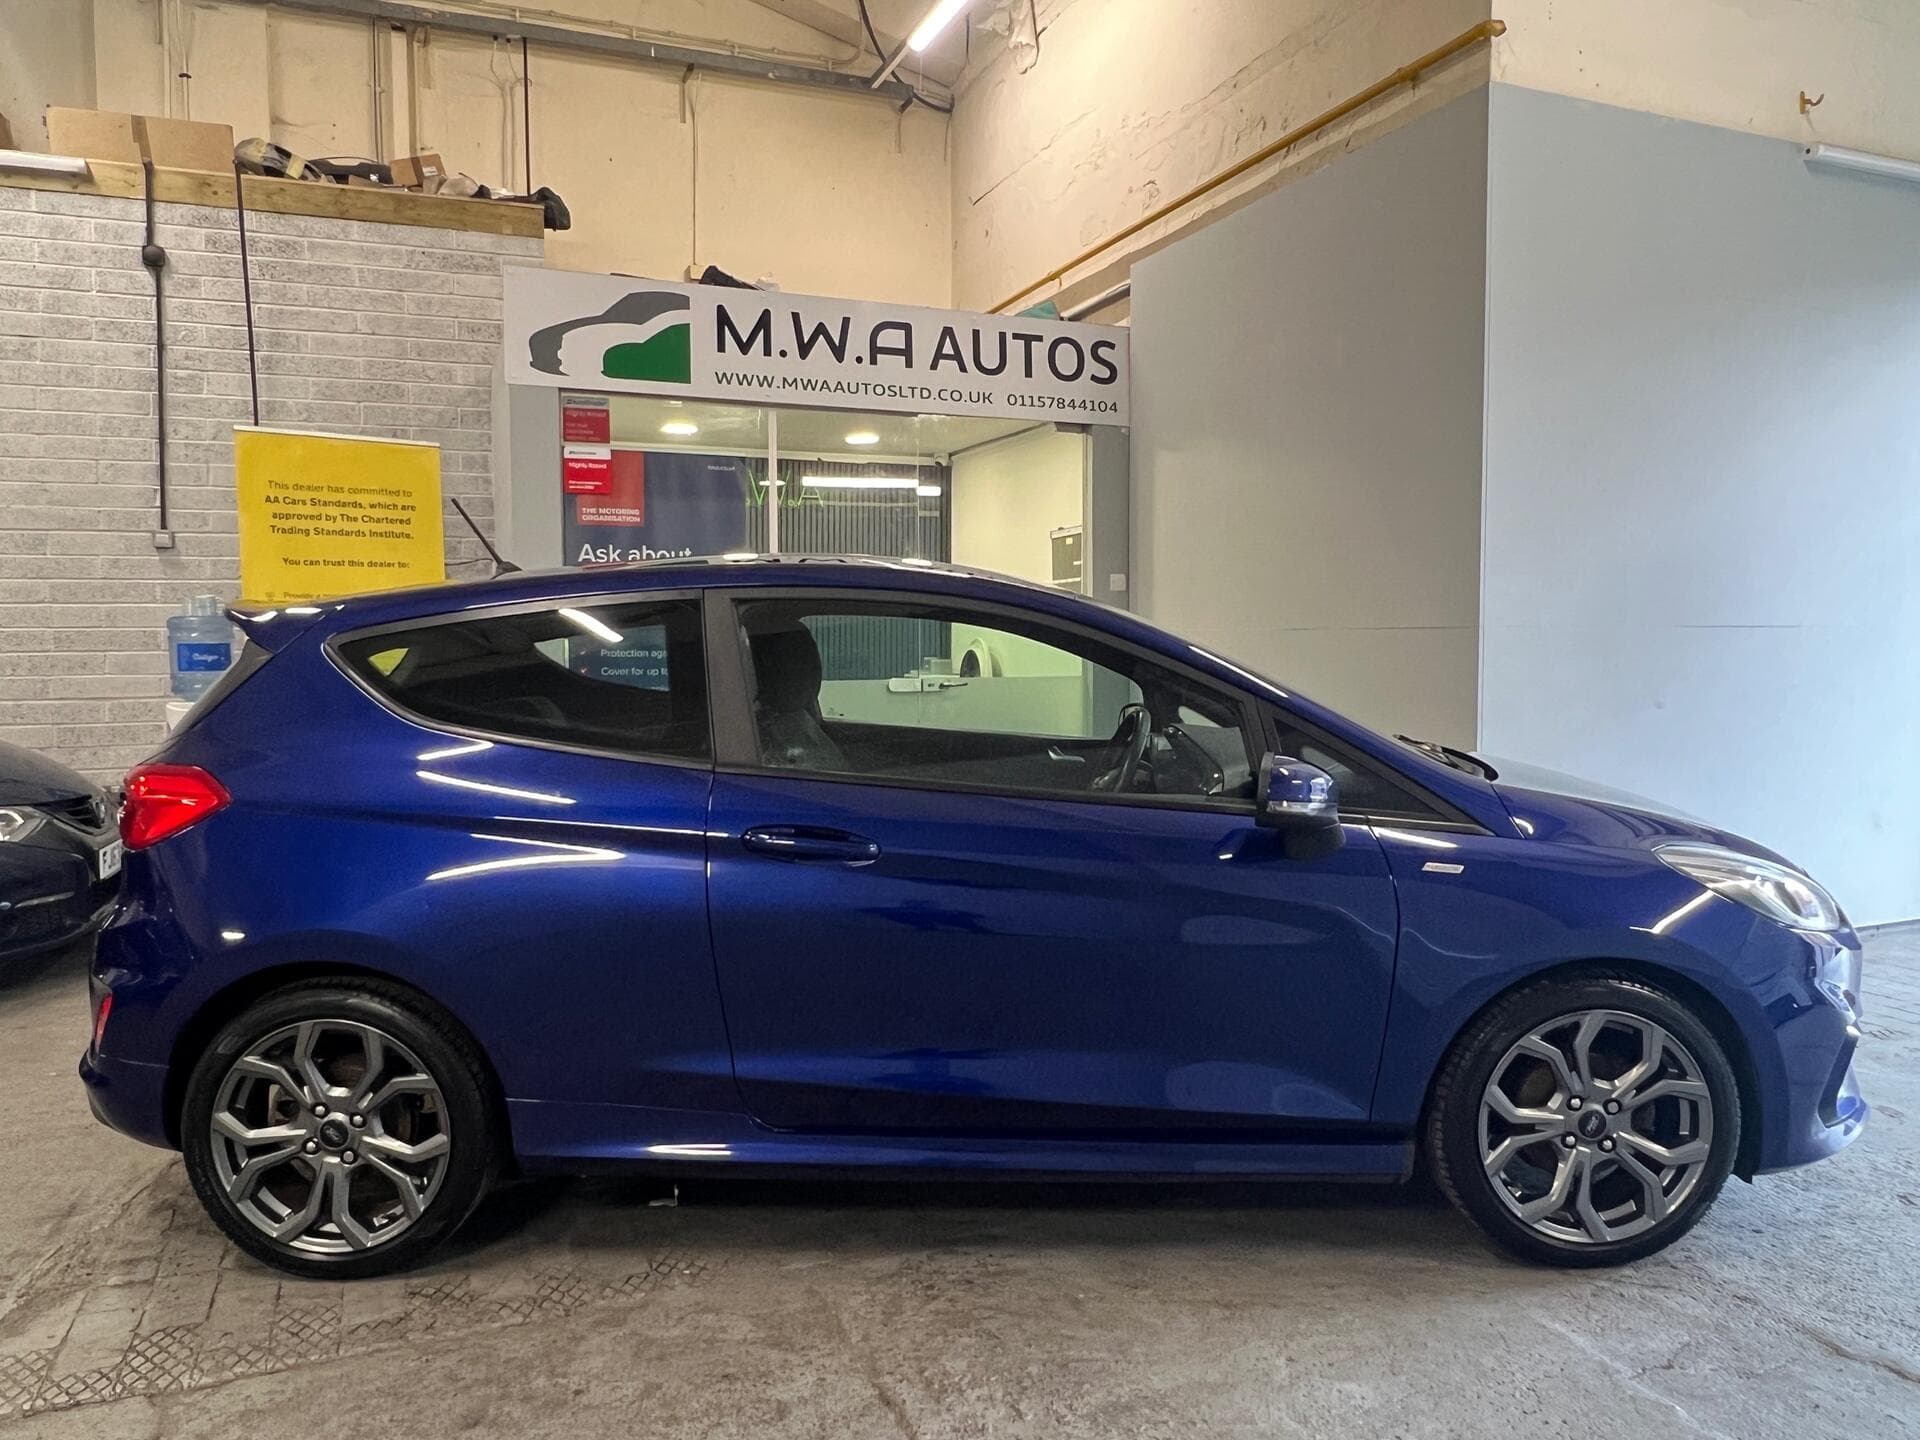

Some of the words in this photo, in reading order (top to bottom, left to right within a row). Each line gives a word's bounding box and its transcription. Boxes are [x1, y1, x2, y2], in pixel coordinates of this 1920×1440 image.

[714, 303, 914, 369] M.W.A
[930, 325, 1119, 386] AUTOS
[714, 370, 993, 405] WWW.MWAAUTOSLTD.CO.UK
[1006, 393, 1119, 414] 01157844104
[267, 480, 290, 490] This
[292, 482, 324, 493] dealer
[327, 484, 345, 494] has
[347, 486, 400, 497] committed
[402, 489, 413, 498] to
[264, 495, 281, 504] AA
[282, 496, 307, 506] Cars
[310, 497, 367, 510] Standards,
[368, 501, 399, 511] which
[400, 504, 417, 512] are
[271, 511, 322, 522] approved
[325, 513, 337, 524] by
[340, 513, 359, 523] The
[361, 514, 411, 526] Chartered
[270, 525, 311, 537] Trading
[313, 526, 367, 538] Standards
[369, 529, 414, 540] Institute.
[578, 544, 621, 563] Ask
[282, 557, 301, 566] You
[303, 558, 321, 567] can
[322, 559, 345, 567] trust
[347, 559, 365, 568] this
[366, 560, 395, 568] dealer
[397, 560, 410, 569] to:
[600, 648, 649, 658] Protection
[600, 666, 629, 676] Cover
[631, 667, 644, 676] for
[646, 668, 659, 676] up
